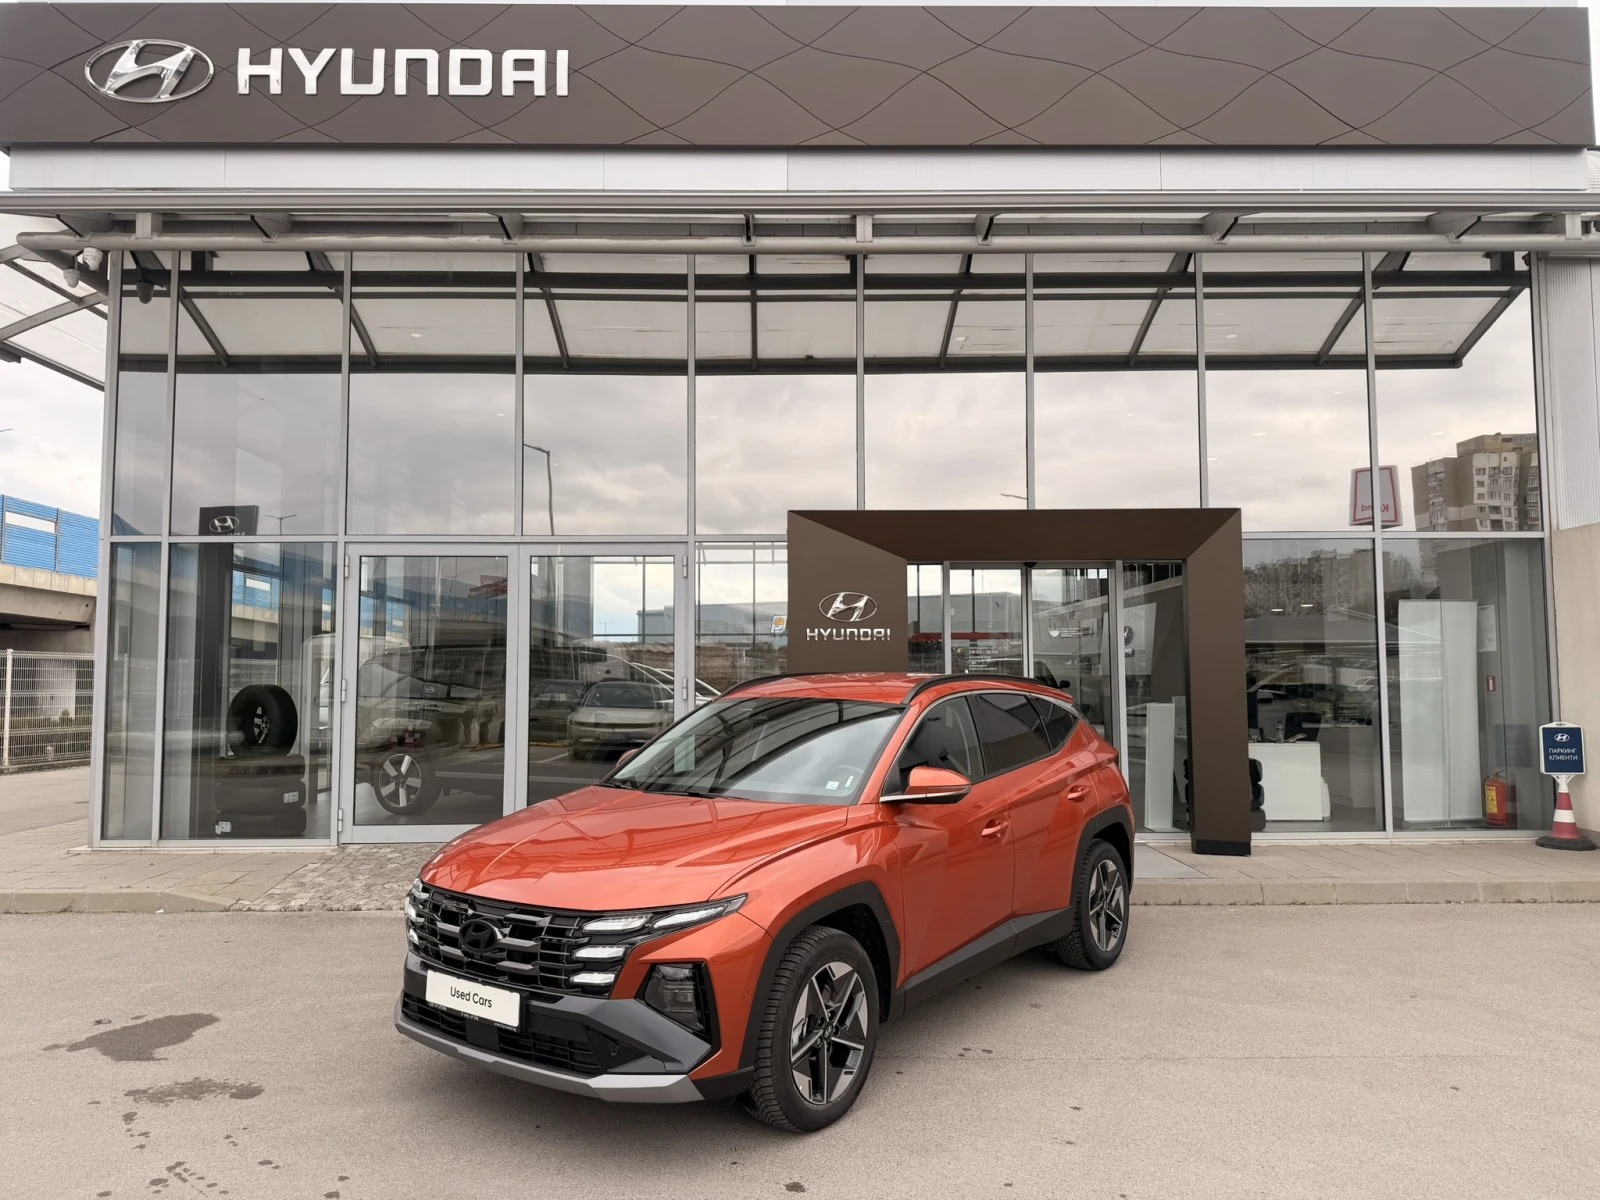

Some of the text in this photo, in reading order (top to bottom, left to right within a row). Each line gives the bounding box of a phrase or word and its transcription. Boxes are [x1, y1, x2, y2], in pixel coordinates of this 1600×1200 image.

[237, 48, 569, 97] HYUNDAI
[806, 628, 891, 641] HYUNDAI
[450, 986, 493, 1008] Used Cars
